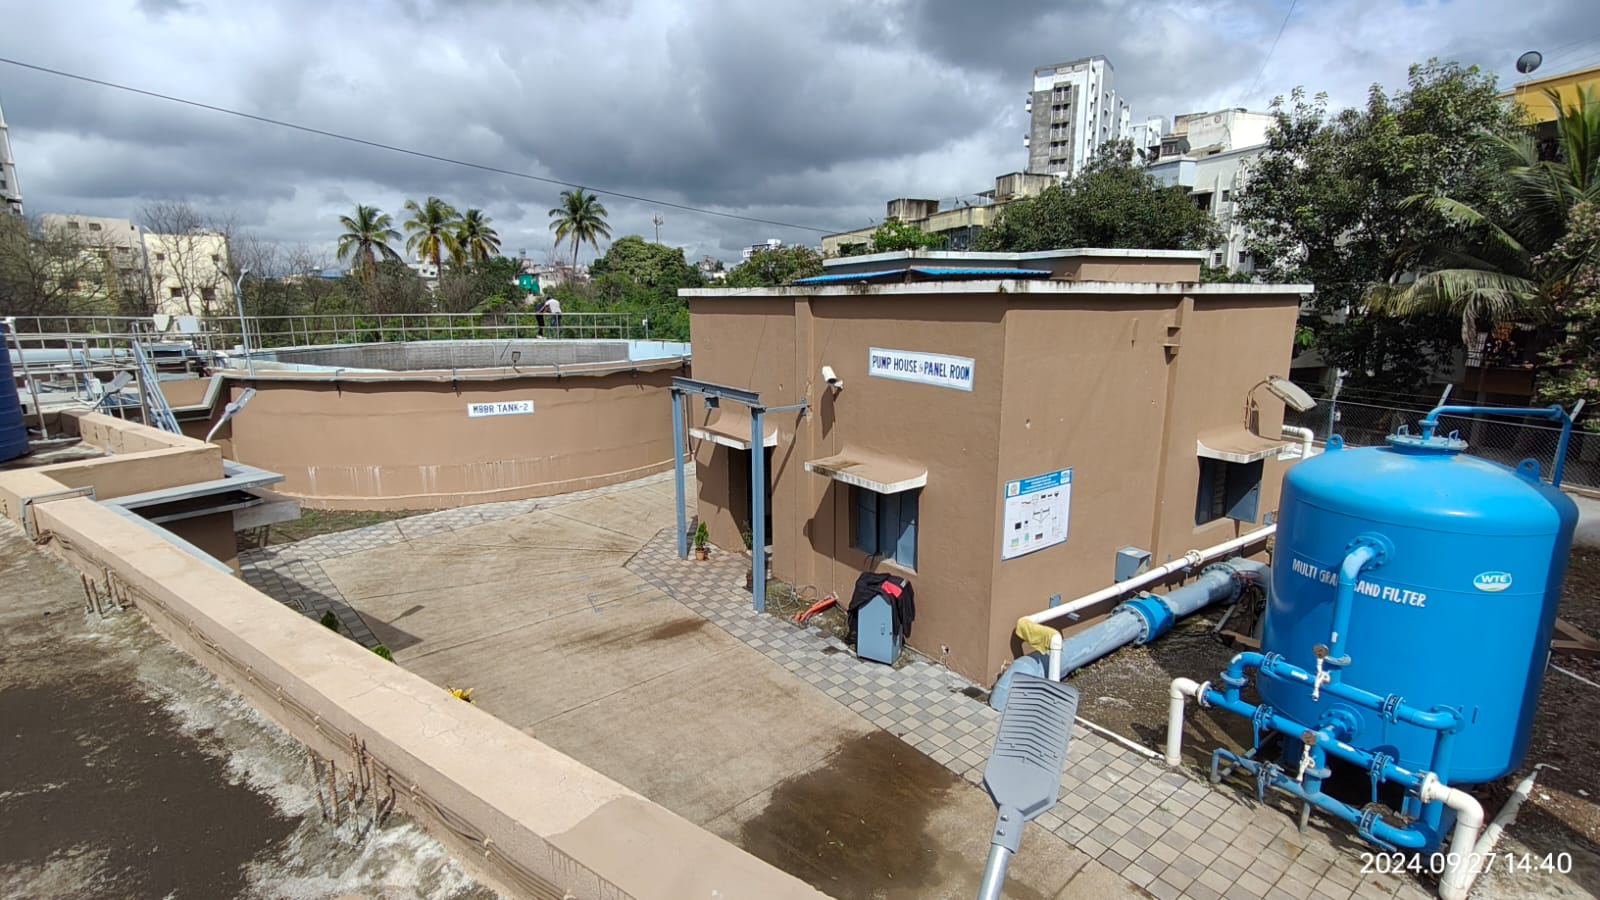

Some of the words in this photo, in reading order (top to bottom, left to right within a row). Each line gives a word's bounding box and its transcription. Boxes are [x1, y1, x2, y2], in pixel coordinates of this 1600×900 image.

[872, 355, 891, 370] PUMP
[893, 358, 917, 373] HOUSE
[924, 361, 947, 378] PANEL
[950, 364, 970, 381] ROOM
[496, 402, 528, 413] TANK-2
[1292, 558, 1318, 579] MULTI
[1382, 586, 1427, 608] FILTER
[1481, 575, 1507, 583] WTE
